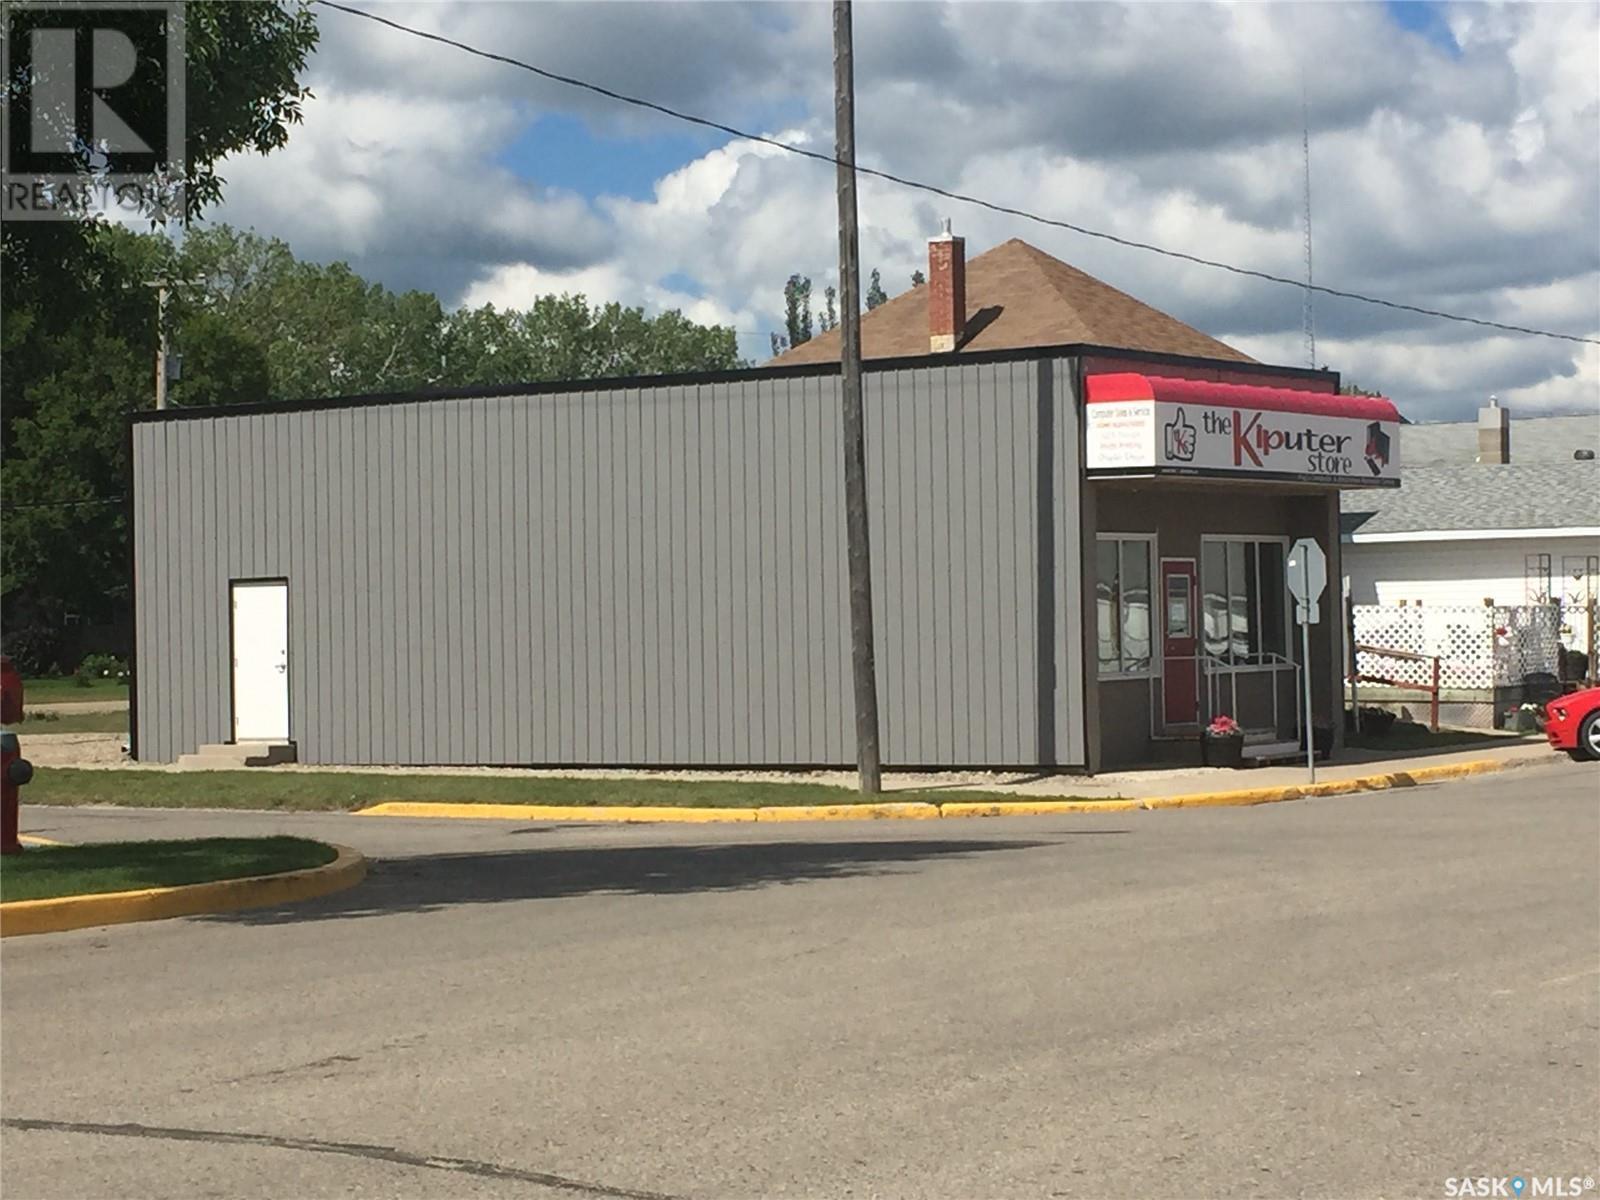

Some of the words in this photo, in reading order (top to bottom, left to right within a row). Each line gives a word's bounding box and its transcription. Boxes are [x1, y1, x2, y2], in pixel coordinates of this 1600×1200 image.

[1203, 410, 1231, 435] the
[1232, 410, 1352, 467] Kiputer
[1308, 453, 1352, 473] store
